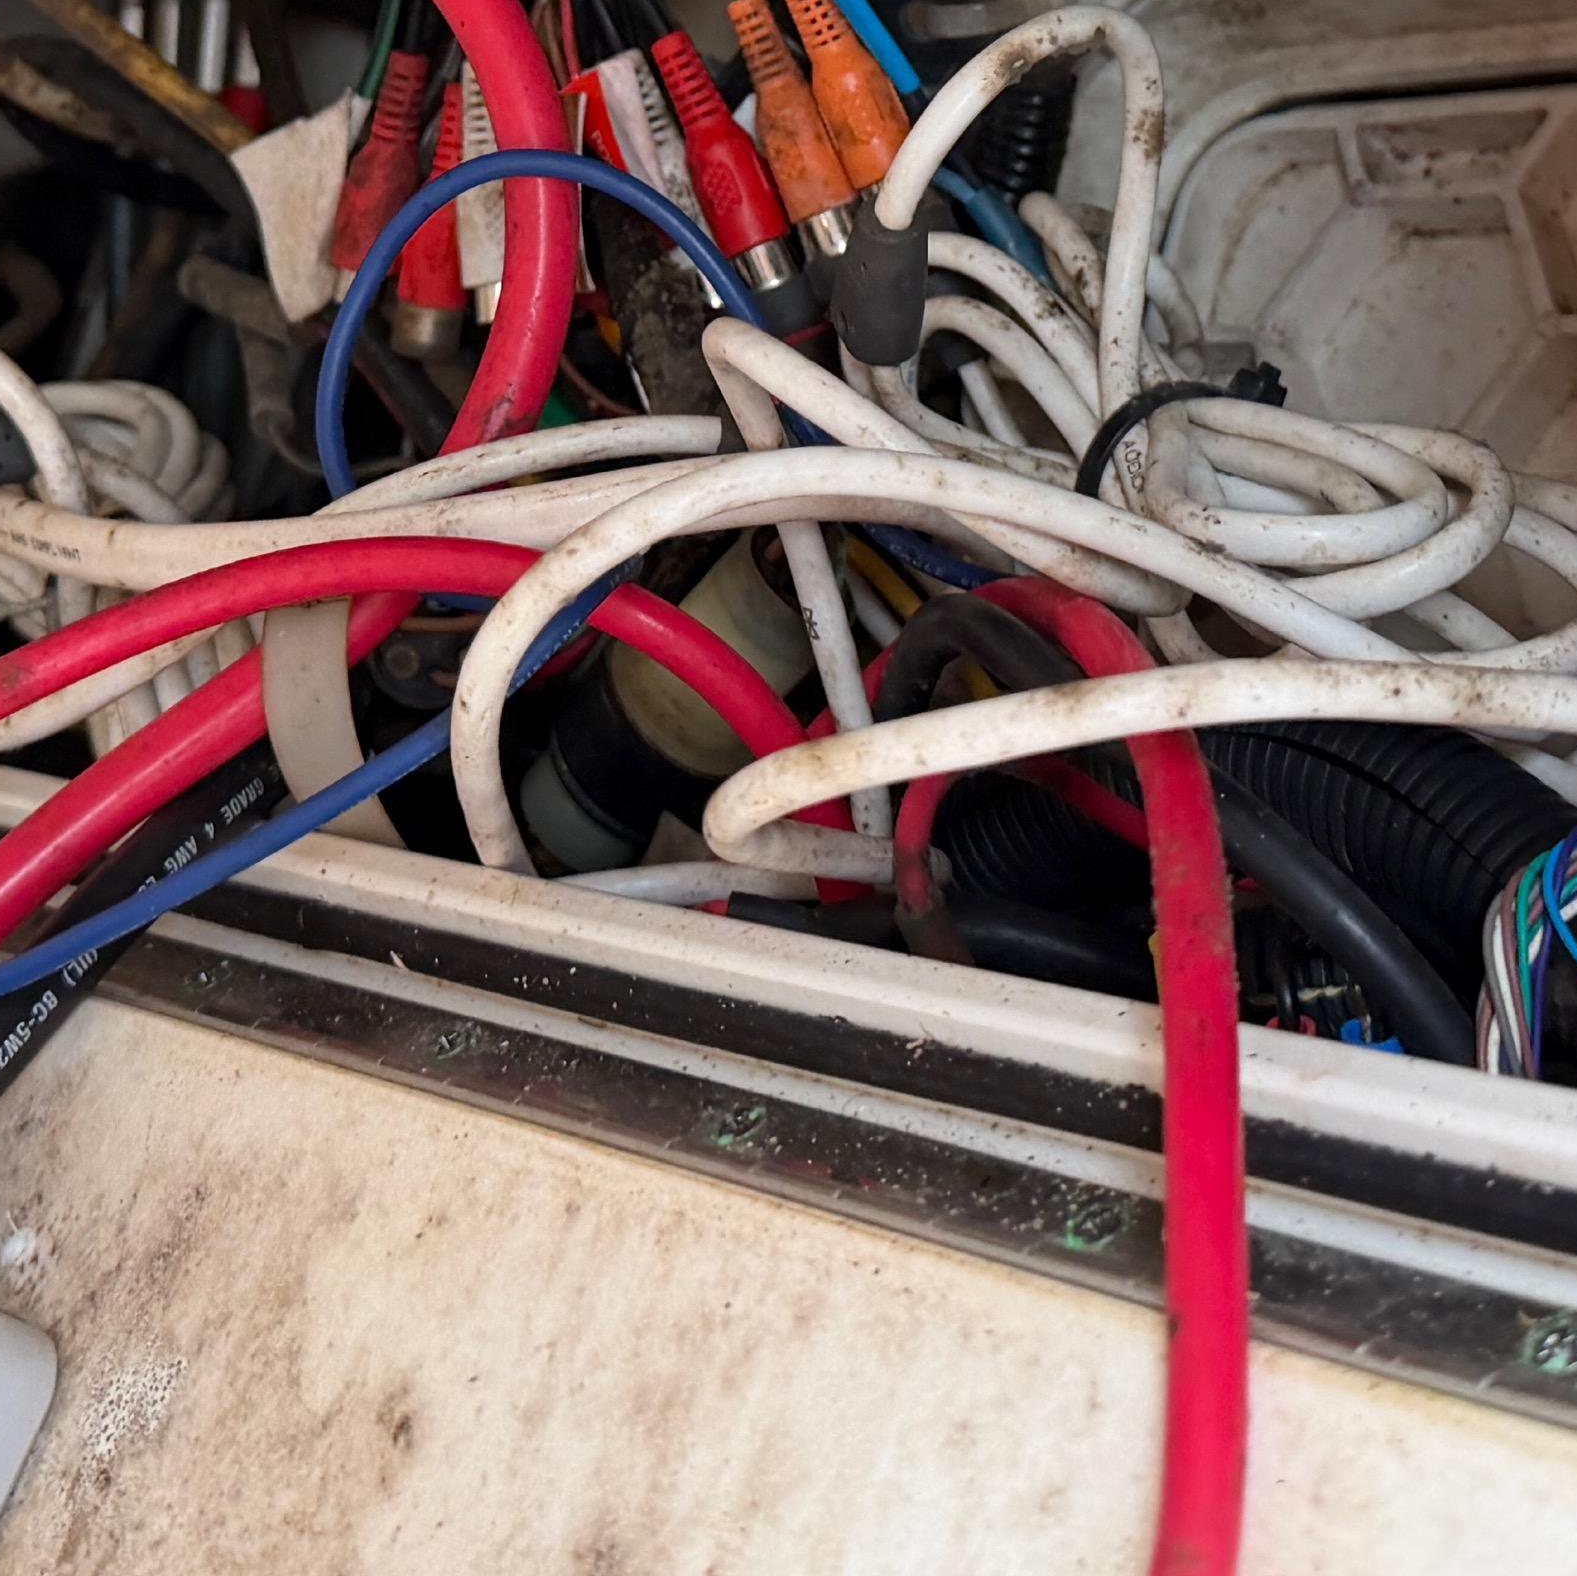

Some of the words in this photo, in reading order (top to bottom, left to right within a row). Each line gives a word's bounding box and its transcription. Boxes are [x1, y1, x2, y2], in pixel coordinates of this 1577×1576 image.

[220, 777, 265, 824] GRADE
[204, 822, 215, 840] 4
[164, 835, 198, 874] AWG
